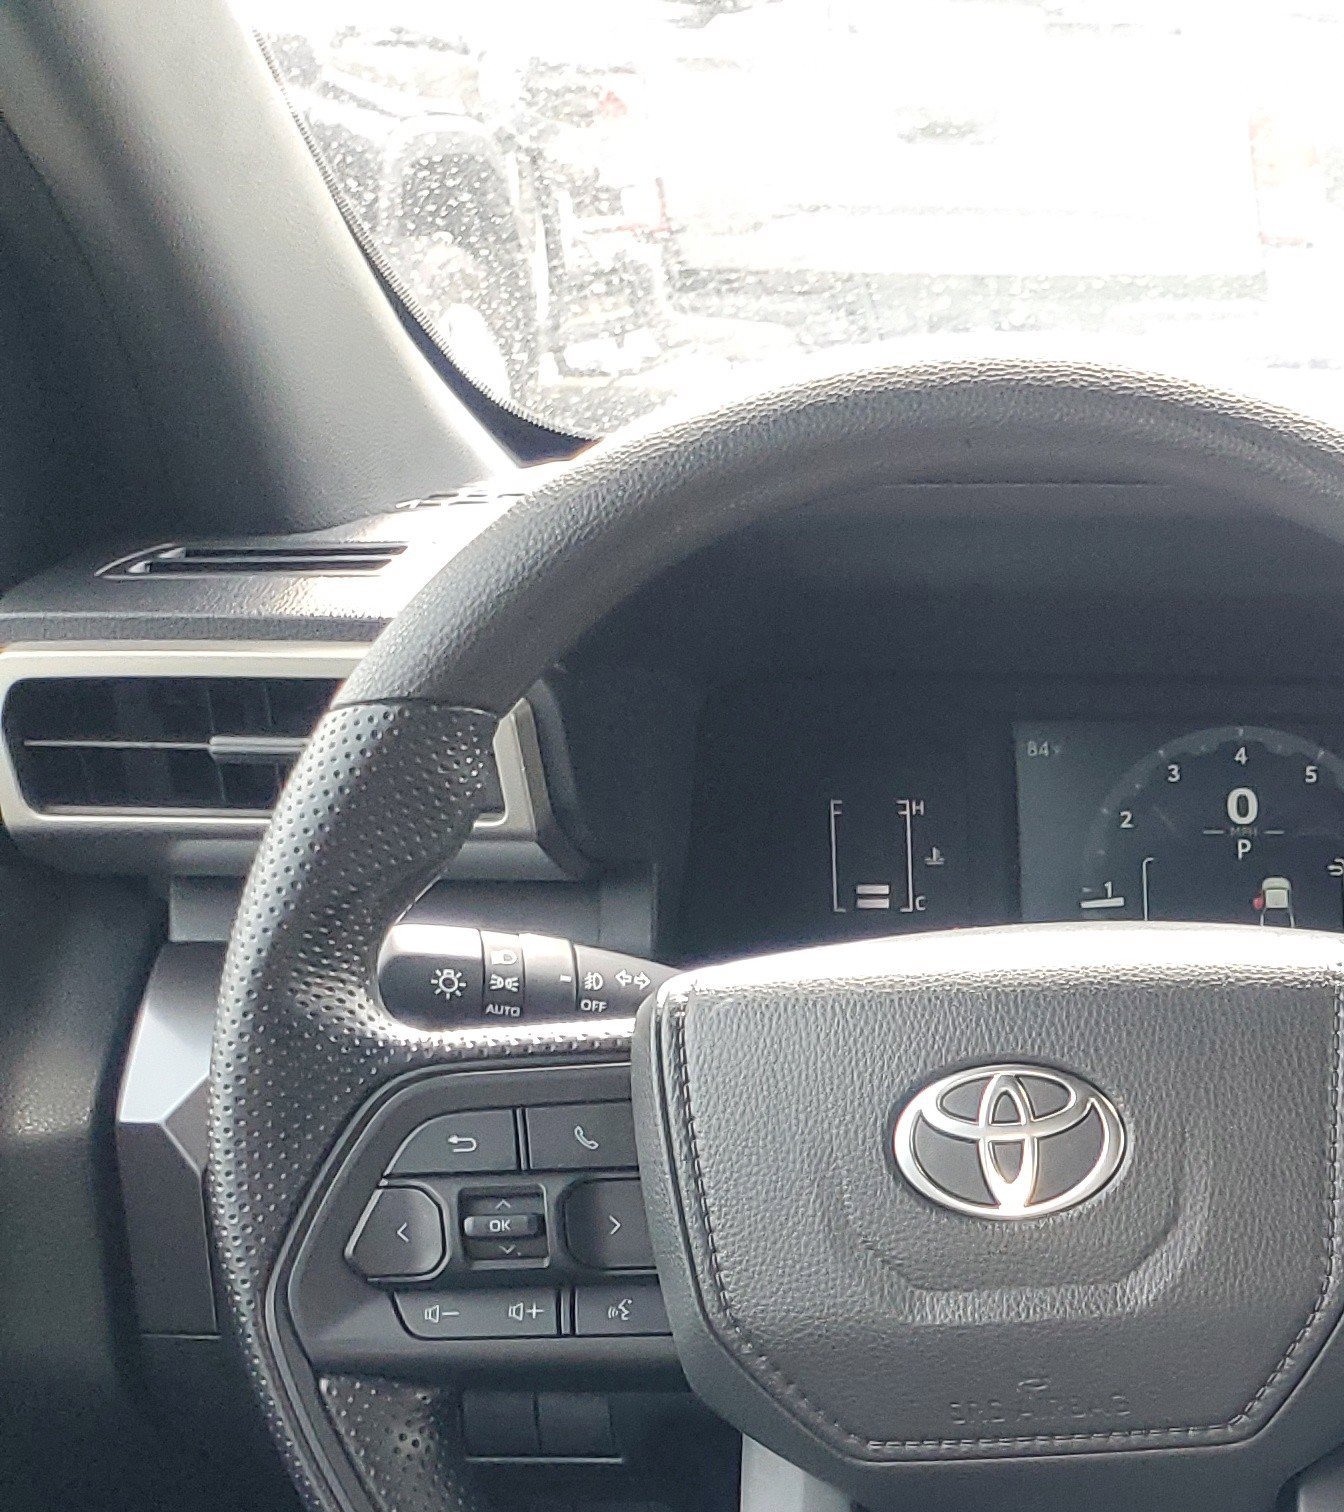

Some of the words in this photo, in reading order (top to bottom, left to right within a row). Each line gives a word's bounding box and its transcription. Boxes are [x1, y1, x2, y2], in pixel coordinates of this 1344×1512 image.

[1234, 746, 1248, 765] 4
[1167, 764, 1180, 782] 3
[1305, 765, 1318, 783] 5
[911, 800, 925, 816] H
[1226, 787, 1259, 825] 0
[1119, 811, 1134, 828] 2
[1237, 839, 1252, 860] P
[1104, 881, 1113, 898] 1
[915, 896, 926, 911] C
[485, 1004, 521, 1018] AUTO
[580, 1000, 607, 1013] OFF
[489, 1219, 511, 1232] OK
